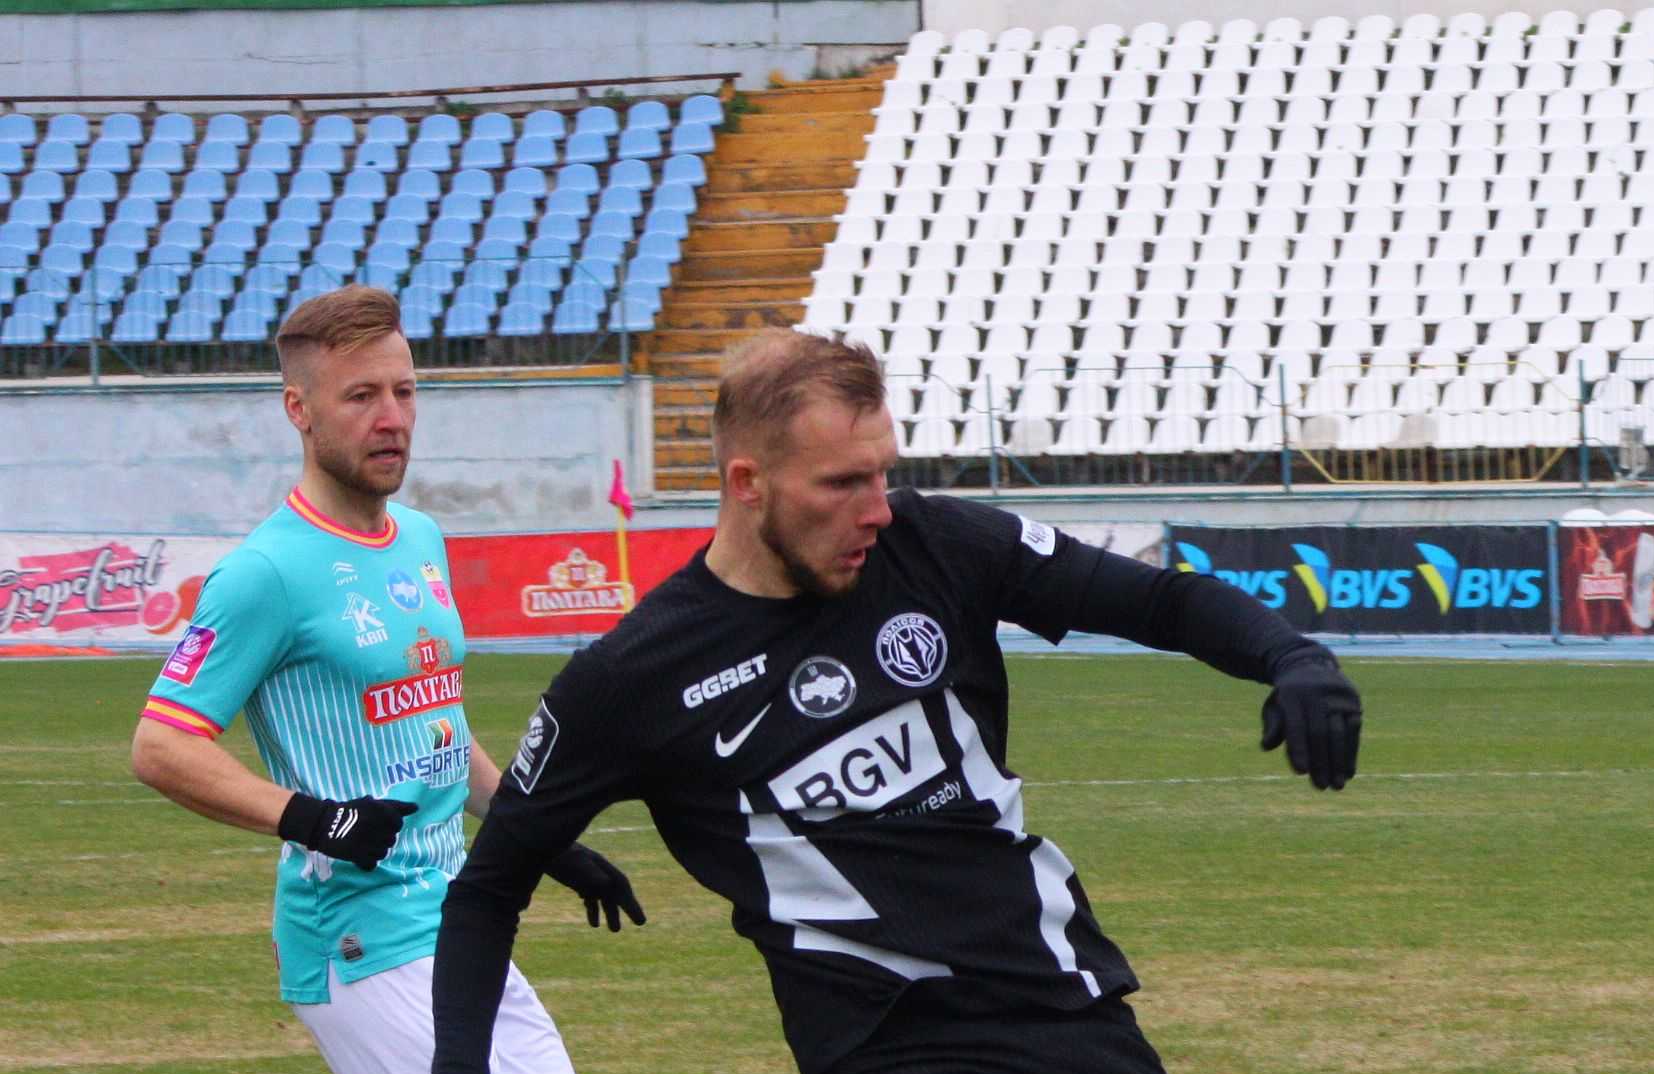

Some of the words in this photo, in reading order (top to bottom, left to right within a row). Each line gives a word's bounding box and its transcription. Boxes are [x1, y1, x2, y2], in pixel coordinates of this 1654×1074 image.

[1330, 570, 1413, 608] BVS
[1455, 569, 1543, 608] BVS
[354, 629, 388, 649] КВП
[370, 670, 463, 719] ПОЛТАВ
[387, 746, 470, 784] INSORTE
[795, 722, 912, 809] BGV
